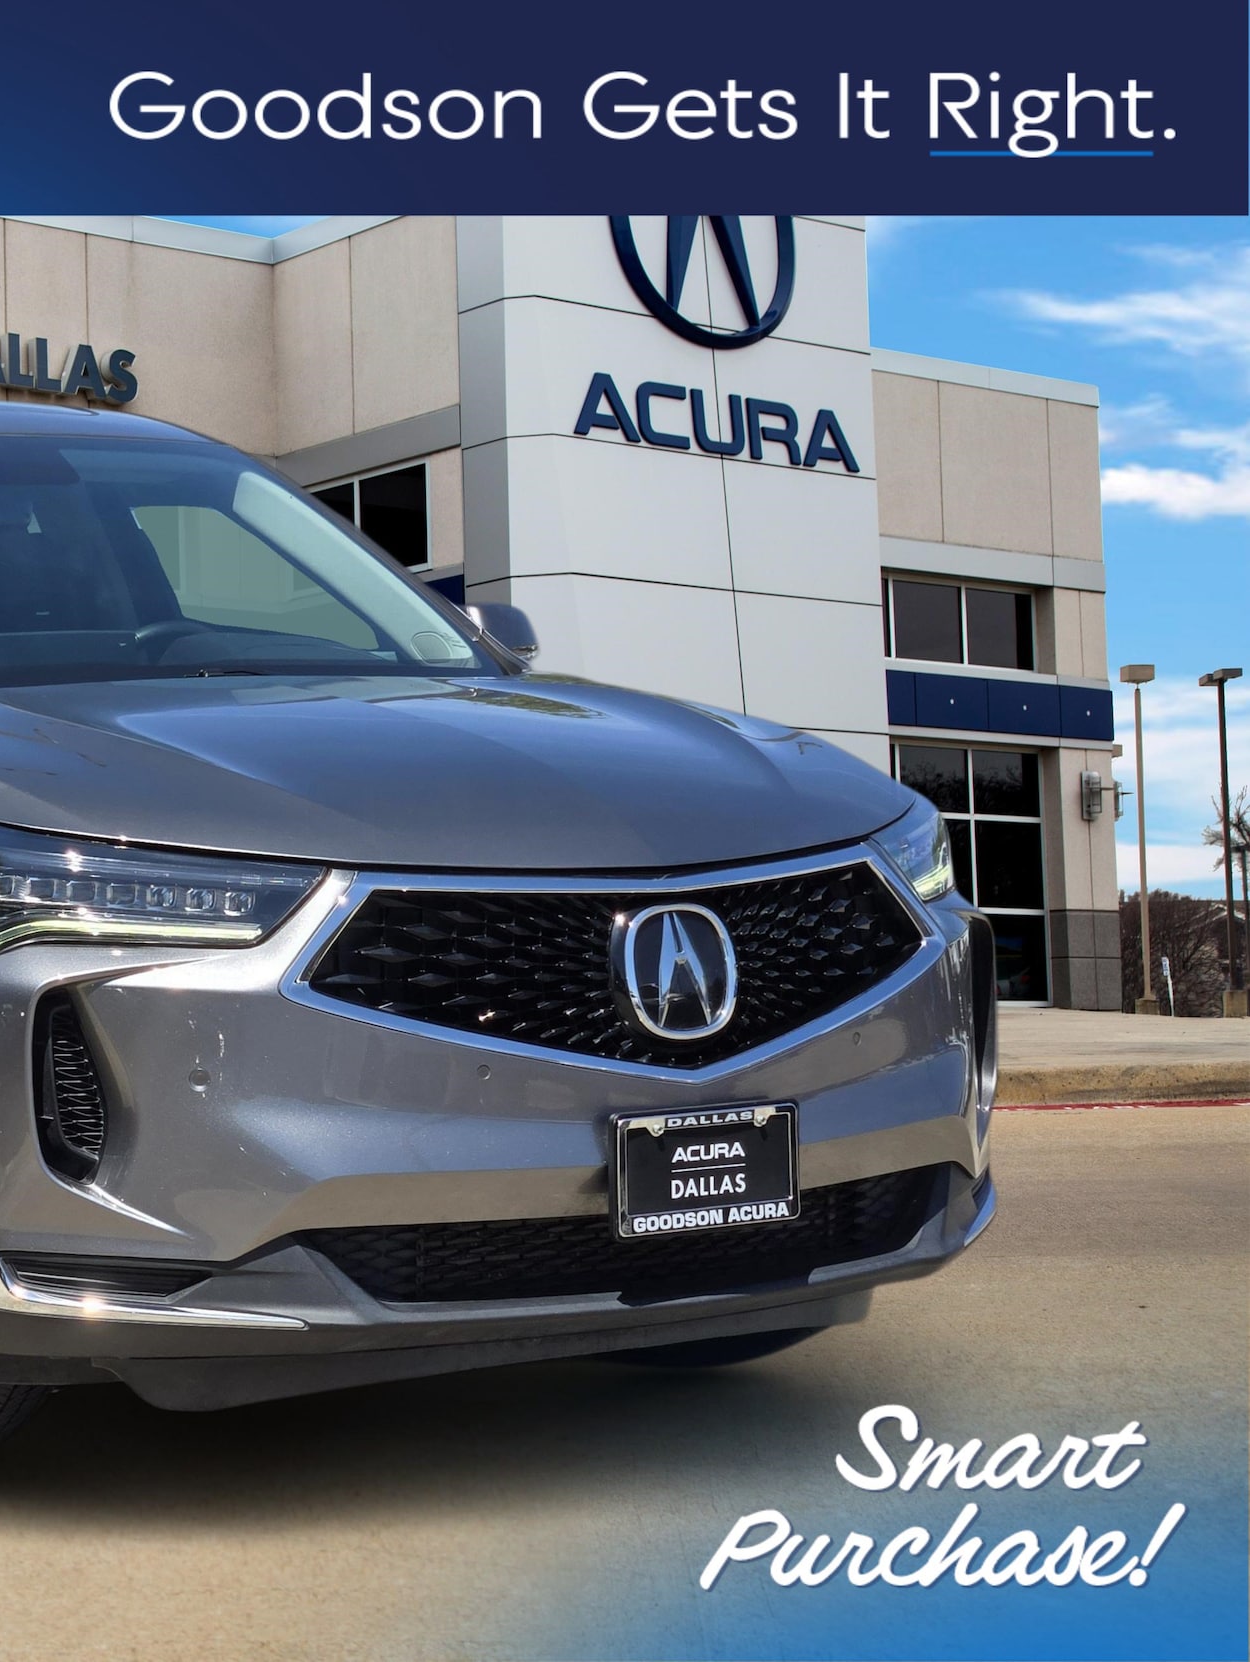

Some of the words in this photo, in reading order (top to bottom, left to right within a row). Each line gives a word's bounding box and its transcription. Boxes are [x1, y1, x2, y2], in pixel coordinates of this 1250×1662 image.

[573, 371, 861, 473] ACURA
[667, 1111, 753, 1127] DALLAS
[671, 1141, 746, 1164] ACURA
[671, 1172, 747, 1200] DALLAS
[633, 1209, 723, 1234] GOODSON
[728, 1202, 790, 1223] ACURA
